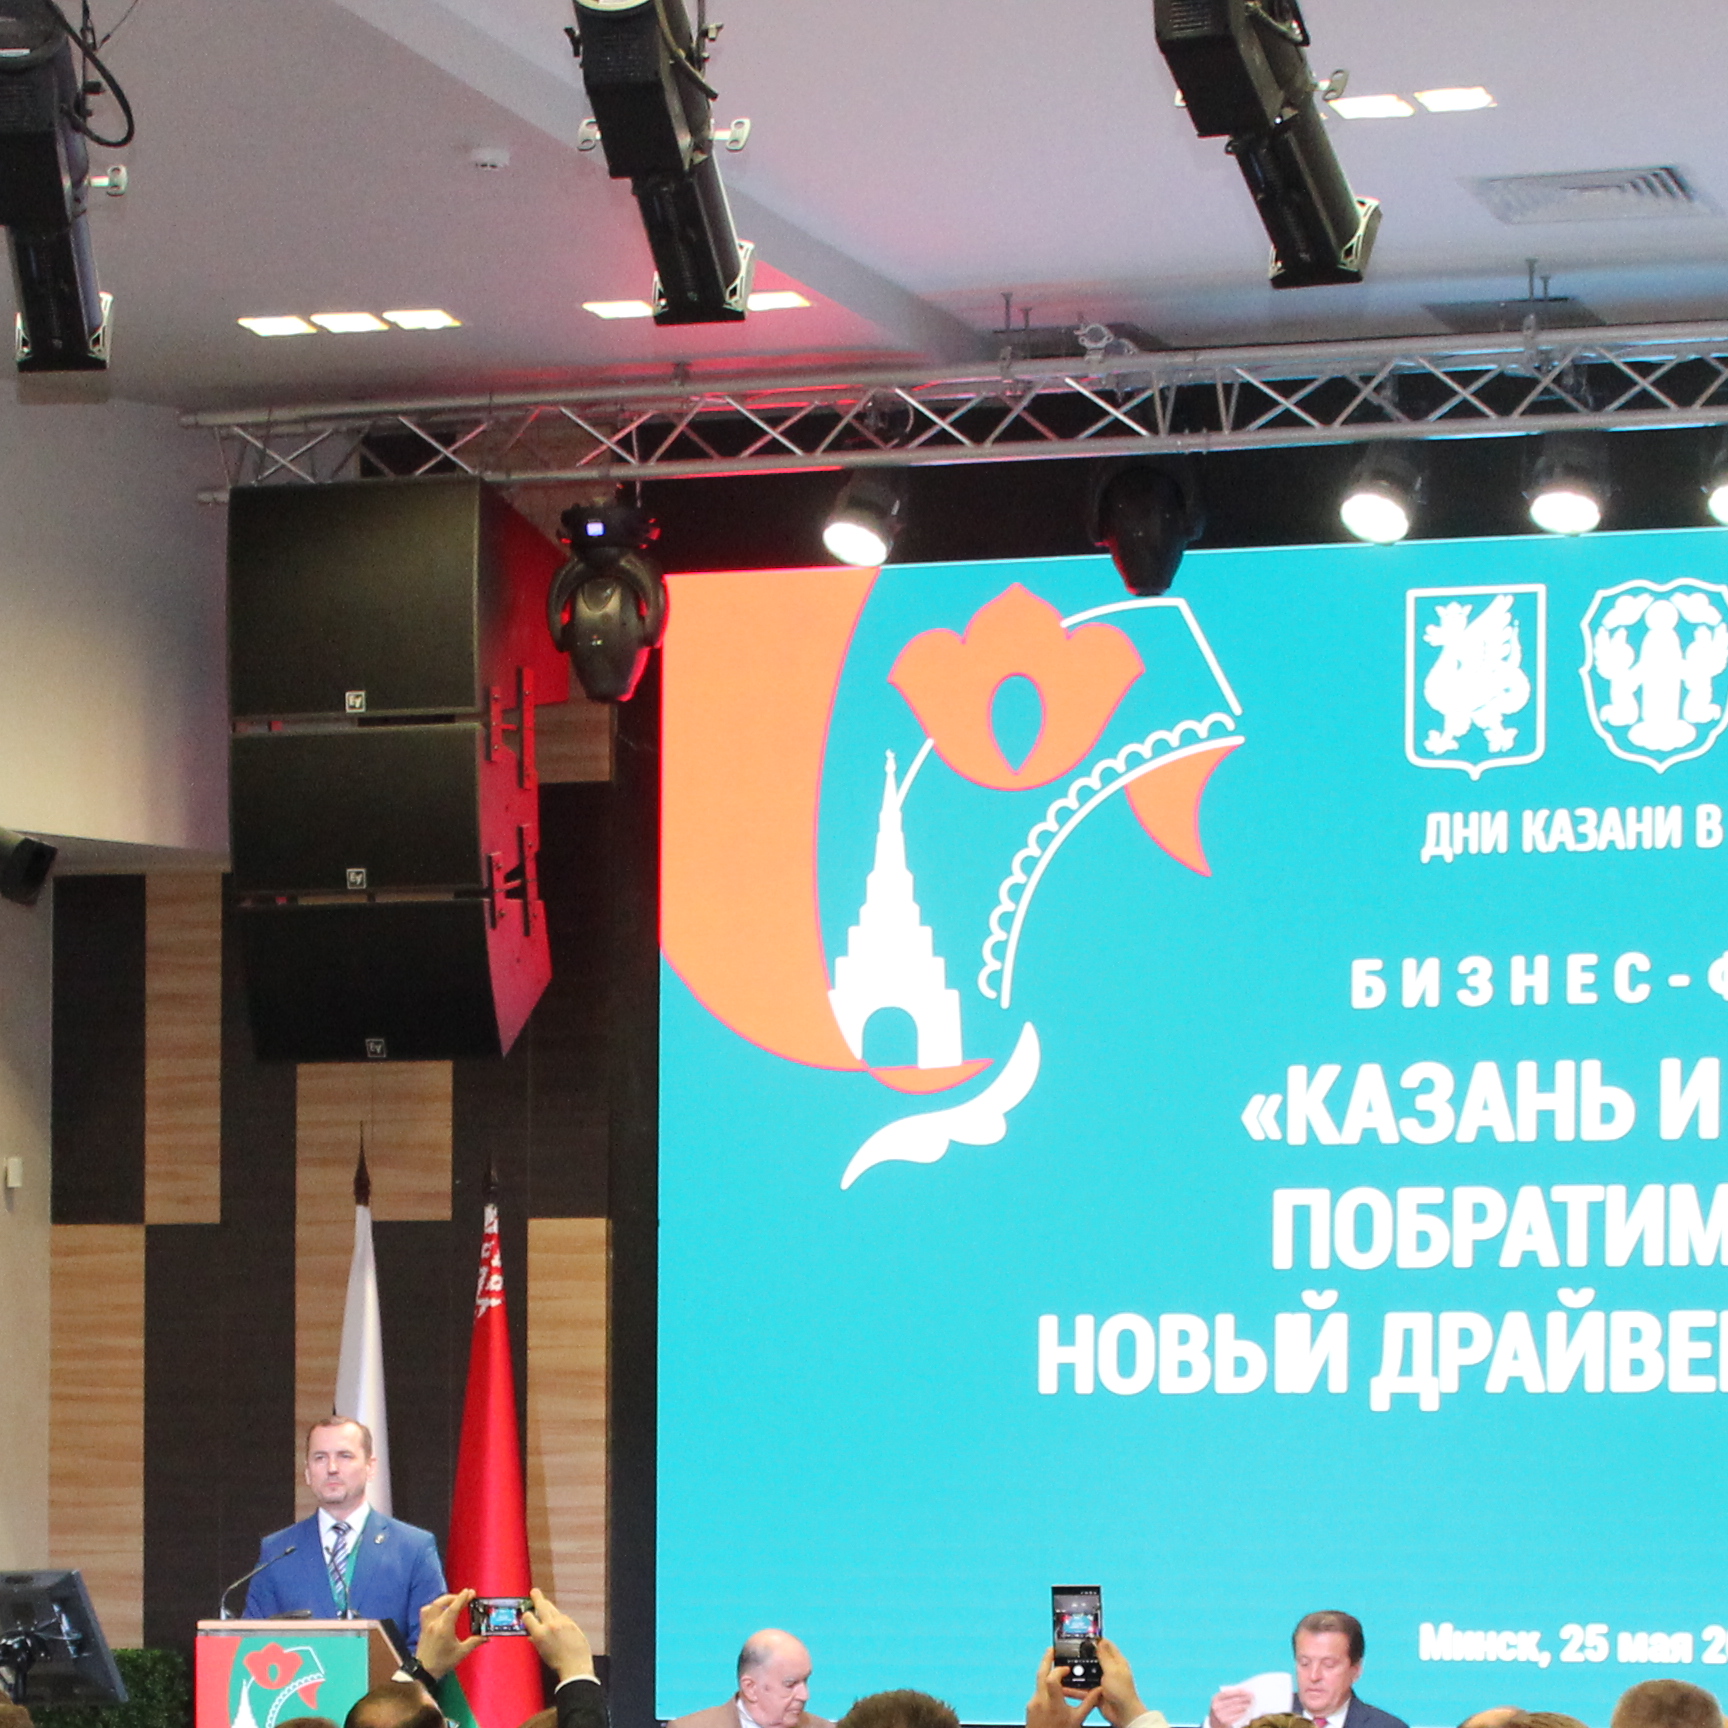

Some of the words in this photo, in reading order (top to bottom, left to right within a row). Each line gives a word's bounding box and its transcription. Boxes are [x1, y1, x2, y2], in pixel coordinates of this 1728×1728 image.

[1419, 809, 1509, 864] ДНИ
[1521, 804, 1684, 854] КАЗАНИ
[1695, 803, 1725, 849] В
[1239, 1058, 1637, 1146] «КАЗАНЬ
[1659, 1056, 1721, 1141] И
[1037, 1288, 1350, 1396] НОВЫЙ
[1418, 1621, 1552, 1669] Минск,
[1558, 1622, 1611, 1664] 25
[1616, 1630, 1696, 1665] мая
